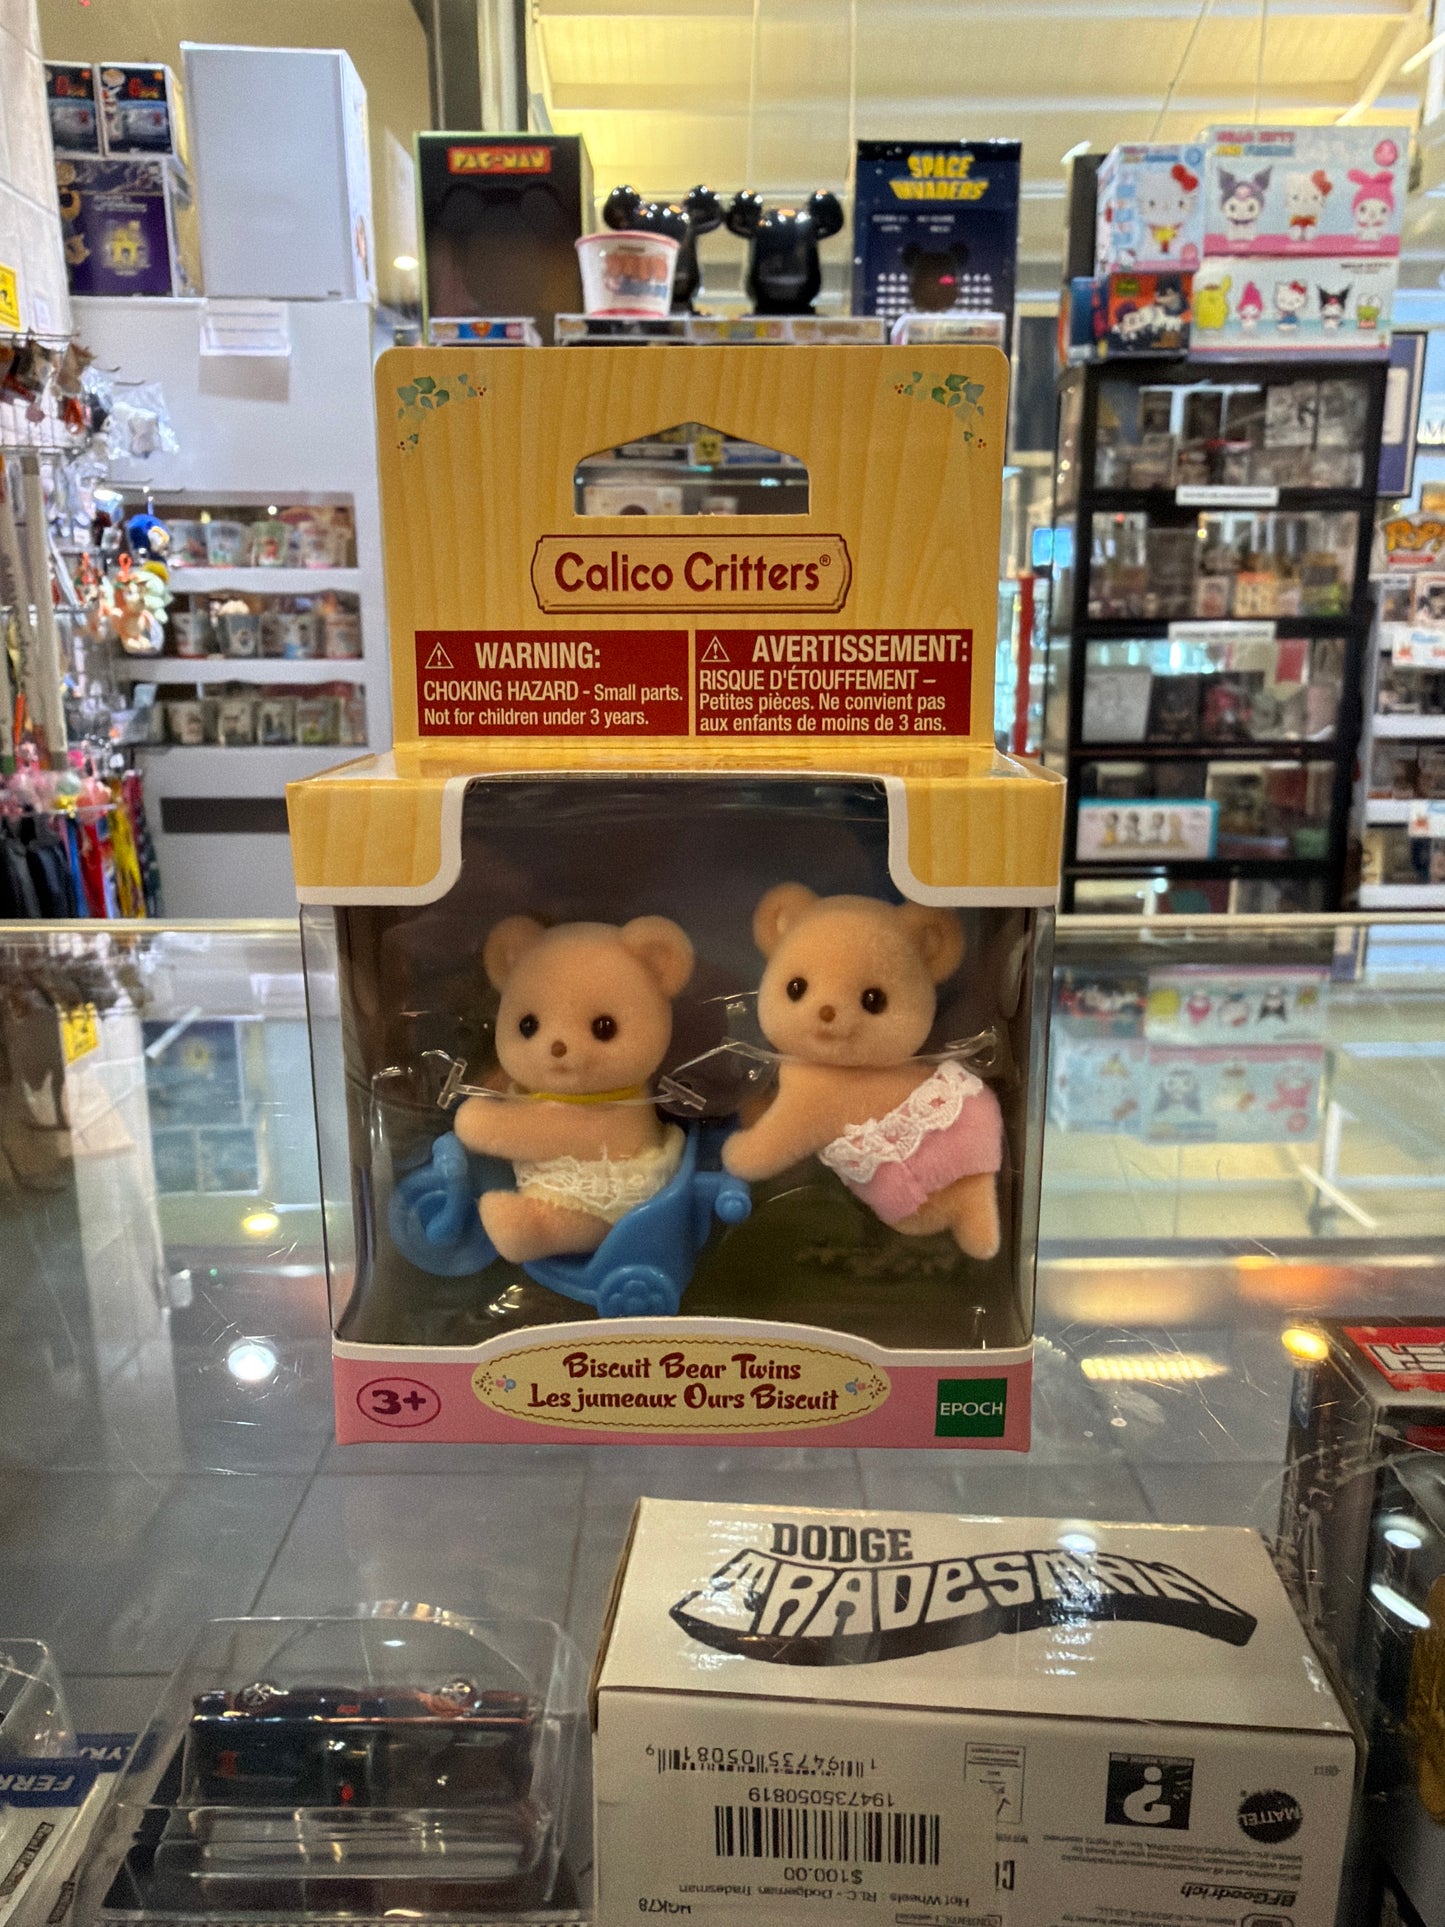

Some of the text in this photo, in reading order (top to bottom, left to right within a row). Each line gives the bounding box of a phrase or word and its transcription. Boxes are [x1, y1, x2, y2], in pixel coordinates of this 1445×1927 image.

[453, 151, 545, 169] PAC-MAN
[907, 152, 975, 178] SPACE
[889, 179, 990, 200] INVADERS
[555, 551, 673, 592] Calico
[475, 642, 601, 669] WARNING:
[752, 635, 968, 663] AVERTISSEMENT:
[700, 669, 764, 691] RISQUE
[770, 665, 919, 690] D'ÉTOUFFEMENT
[424, 681, 502, 701] CHOKING
[507, 681, 579, 701] HAZARD
[594, 684, 636, 701] Small
[641, 685, 683, 704] parts.
[700, 692, 946, 714] Petites pièces. Ne convient pas
[424, 708, 649, 729] Not for children under 3 years.
[700, 714, 947, 731] aux enfants de moins de 3 ans.
[562, 1351, 801, 1379] Biscuit Bear Twins
[371, 1389, 427, 1415] 3+
[527, 1383, 838, 1412] Les jumeaux Ours Biscuit
[940, 1402, 1003, 1416] EPOCH
[770, 1523, 913, 1563] DODGE
[748, 1787, 895, 1807] 194735050819
[1238, 1807, 1301, 1827] MATTEL
[783, 1867, 863, 1884] $100.00
[845, 1890, 877, 1903] RLC
[889, 1892, 941, 1907] Wheels
[945, 1895, 970, 1909] Hot
[1181, 1883, 1297, 1906] BFGoodrich
